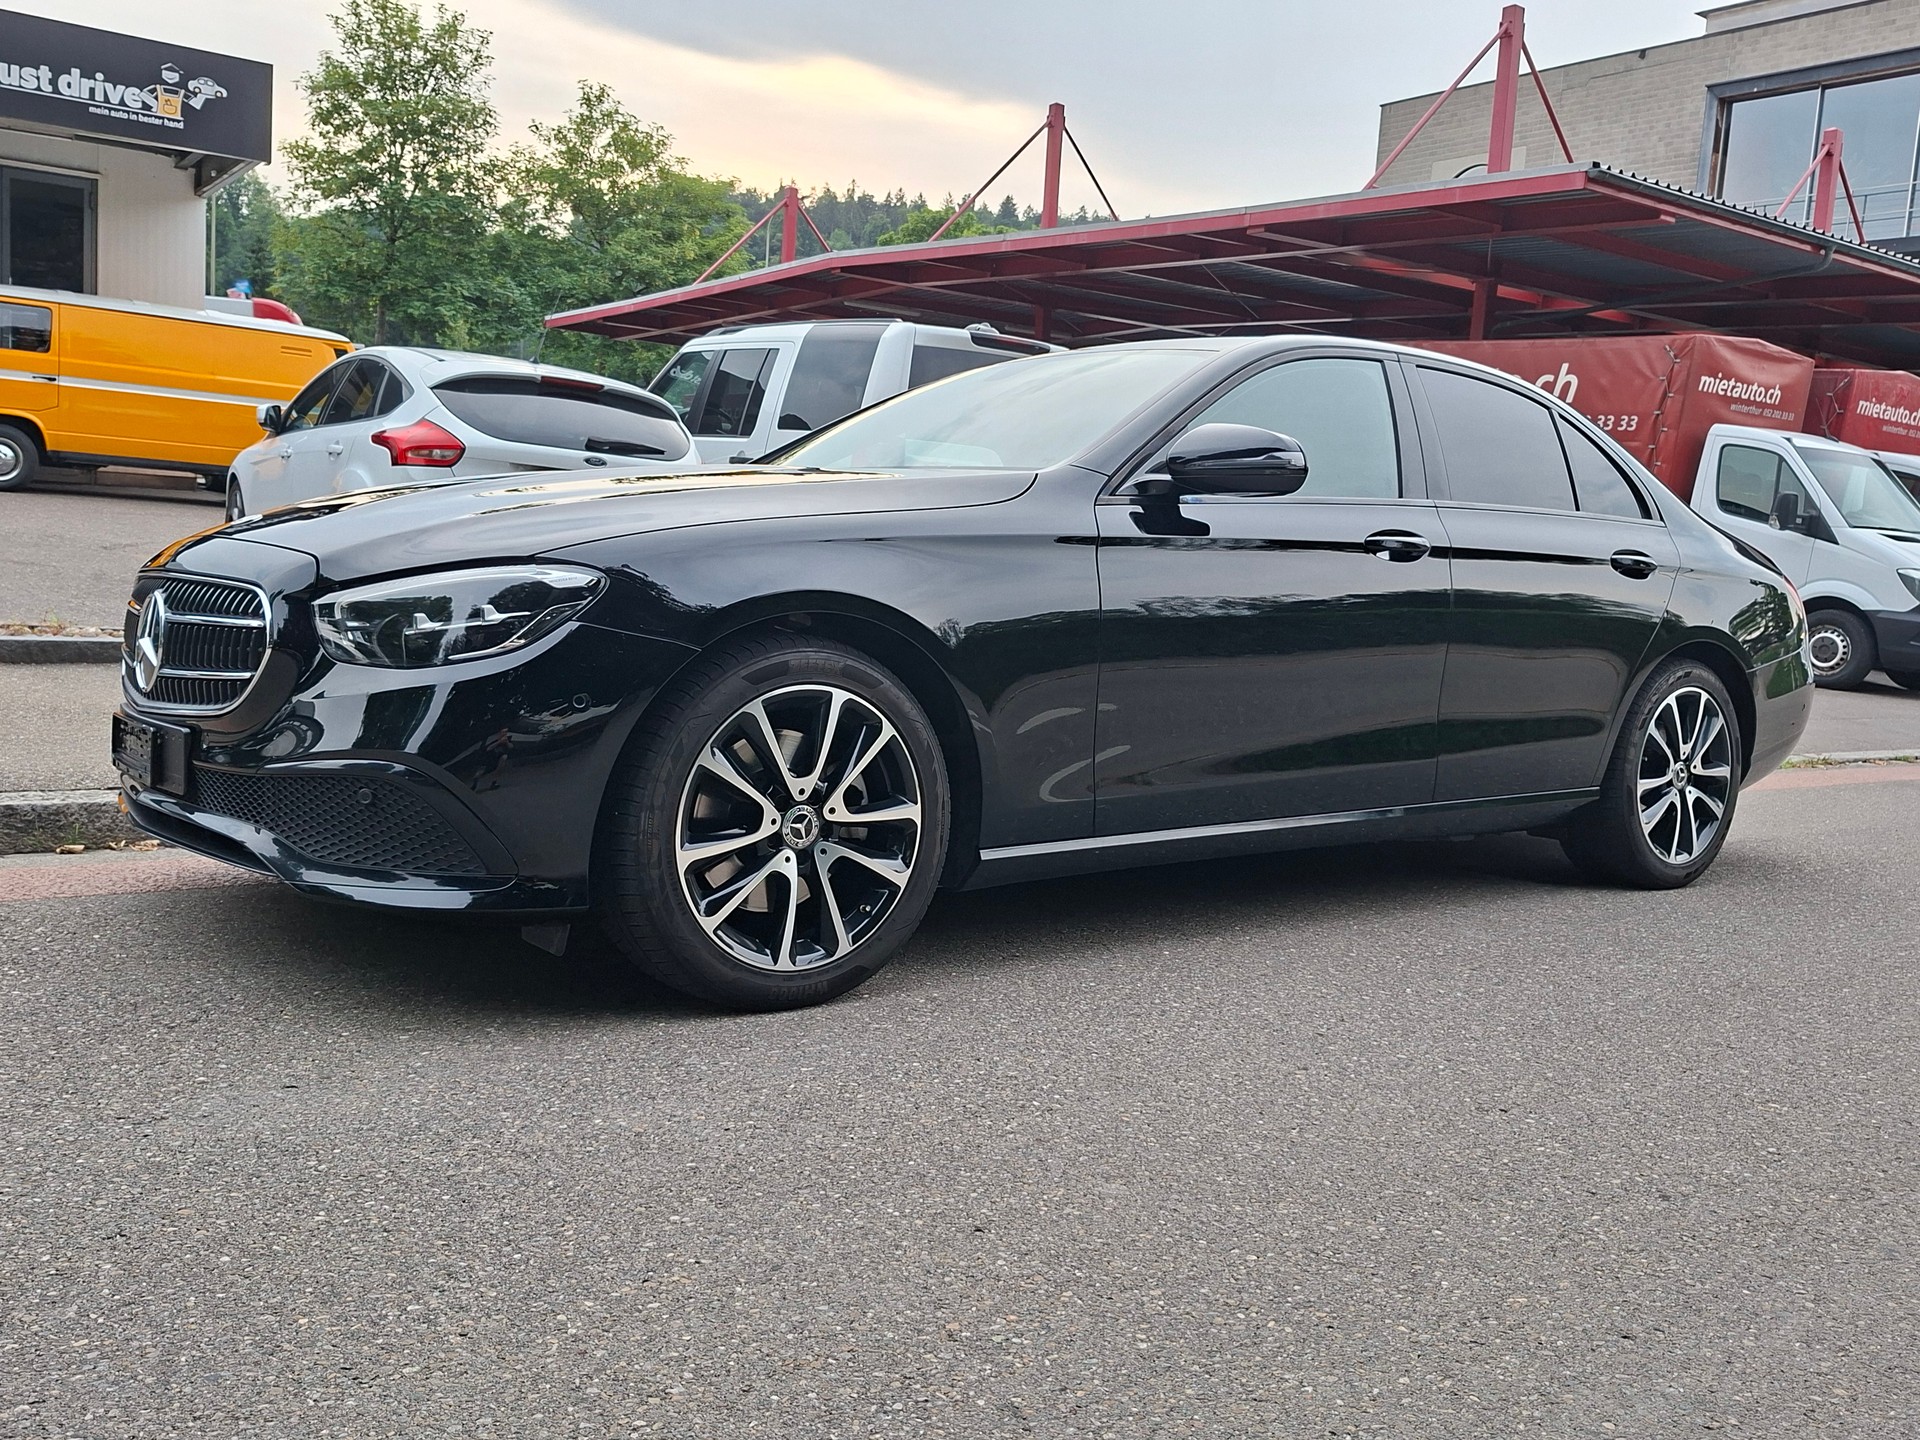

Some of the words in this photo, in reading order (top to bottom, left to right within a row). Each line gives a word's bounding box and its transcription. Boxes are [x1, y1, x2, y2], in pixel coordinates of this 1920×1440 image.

[0, 61, 53, 93] ust
[57, 67, 143, 109] drive
[88, 106, 110, 116] mein
[110, 109, 129, 119] auto
[129, 111, 138, 121] in
[138, 113, 163, 125] bester
[163, 119, 184, 129] hand
[1698, 372, 1782, 405] mietauto.ch
[1730, 402, 1762, 415] winterthur
[1763, 408, 1773, 416] 052
[1772, 410, 1782, 418] 202
[1597, 415, 1615, 431] 33
[1617, 415, 1638, 431] 33
